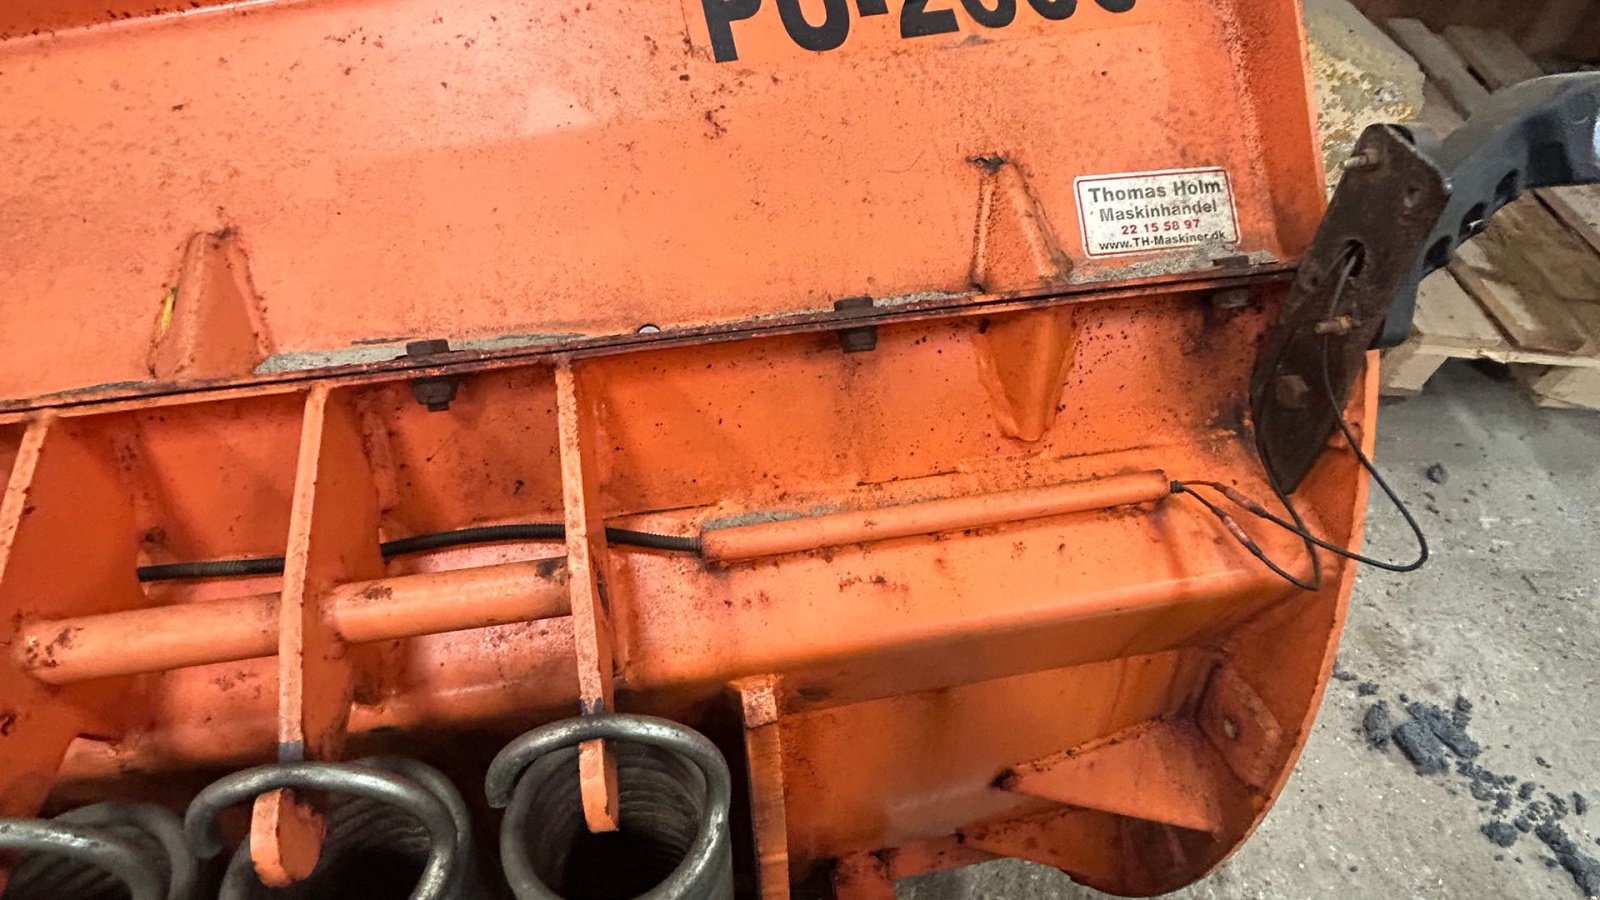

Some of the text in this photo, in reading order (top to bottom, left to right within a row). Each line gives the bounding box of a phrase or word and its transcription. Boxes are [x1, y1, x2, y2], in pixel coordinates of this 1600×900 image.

[1088, 180, 1221, 203] Thomas Holm
[1099, 200, 1217, 222] Maskinhandel
[1121, 219, 1200, 235] 22 15 58 97
[1099, 230, 1226, 250] www.TH-Maskiner.dk
